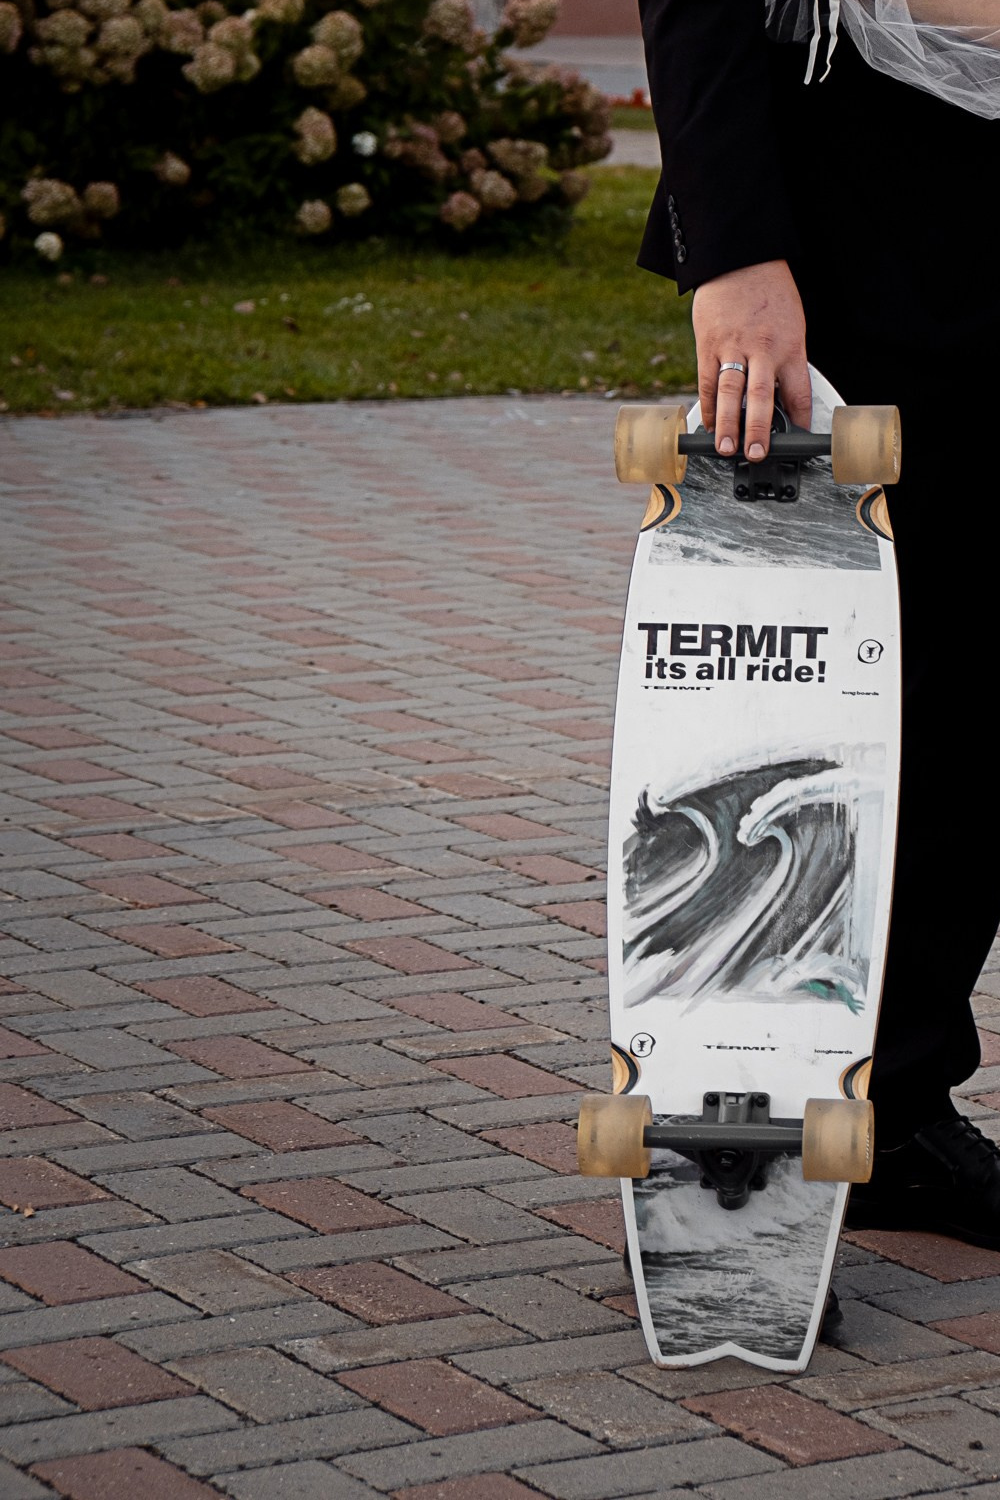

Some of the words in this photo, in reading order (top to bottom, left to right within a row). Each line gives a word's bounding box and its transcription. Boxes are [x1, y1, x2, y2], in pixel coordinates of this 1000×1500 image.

[637, 622, 829, 659] TERMIT
[645, 656, 687, 680] its
[695, 657, 737, 681] all
[746, 658, 827, 683] ride!
[702, 1043, 780, 1052] TERMIT
